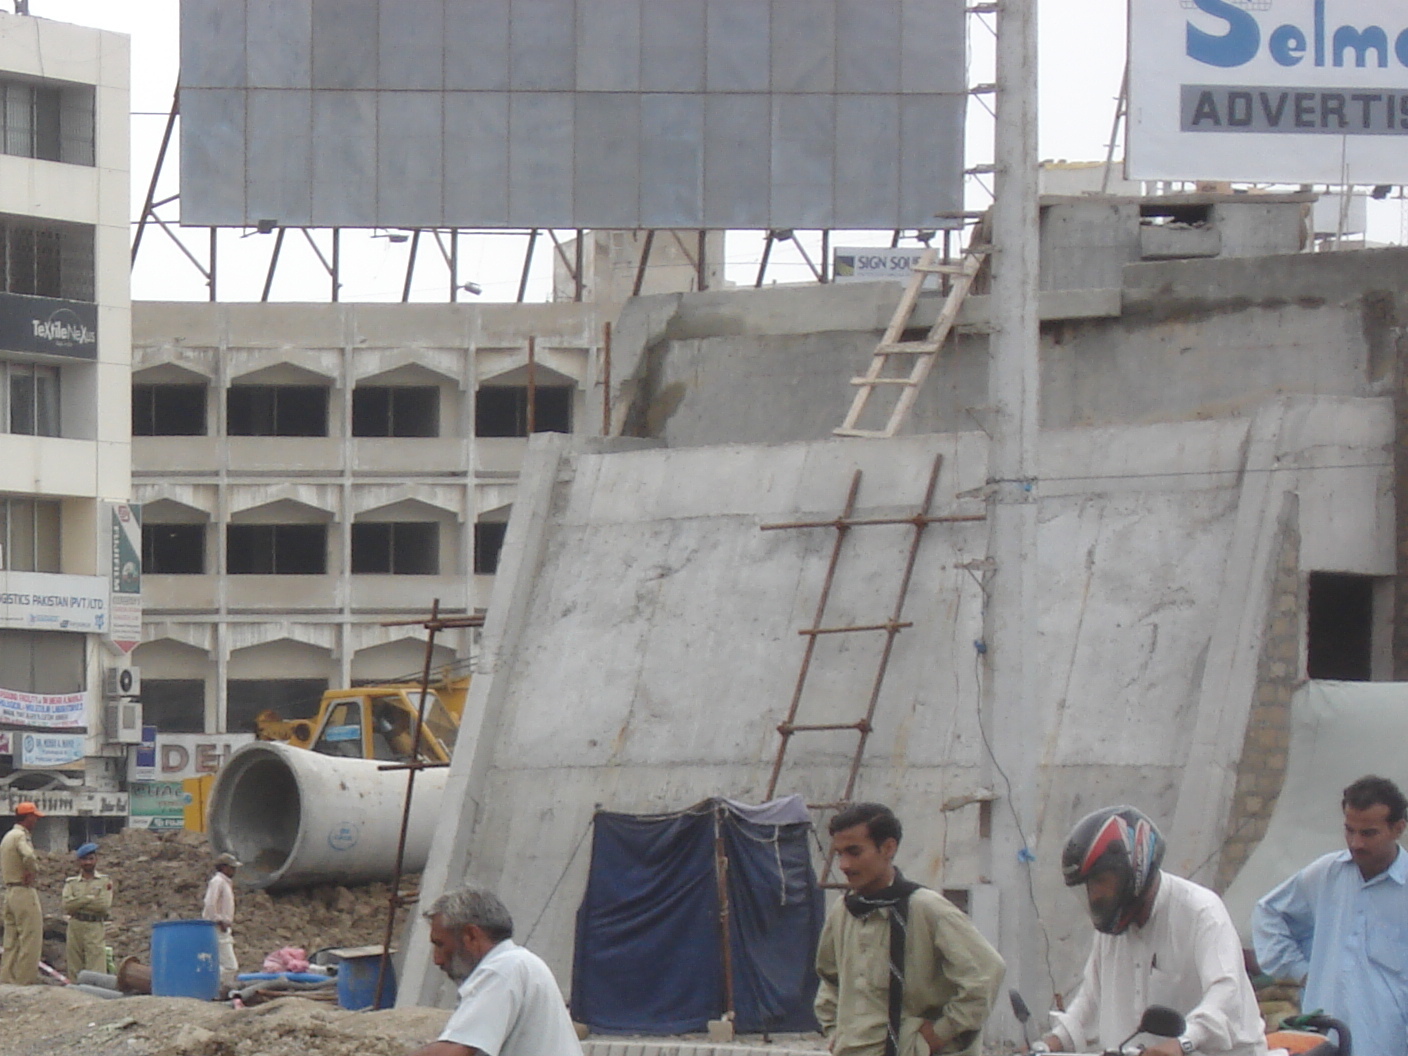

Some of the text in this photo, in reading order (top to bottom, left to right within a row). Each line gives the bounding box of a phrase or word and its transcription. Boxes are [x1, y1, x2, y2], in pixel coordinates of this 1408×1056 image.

[1186, 0, 1408, 68] Selm
[858, 256, 886, 270] SIGN
[33, 595, 68, 607] PAKISTAN
